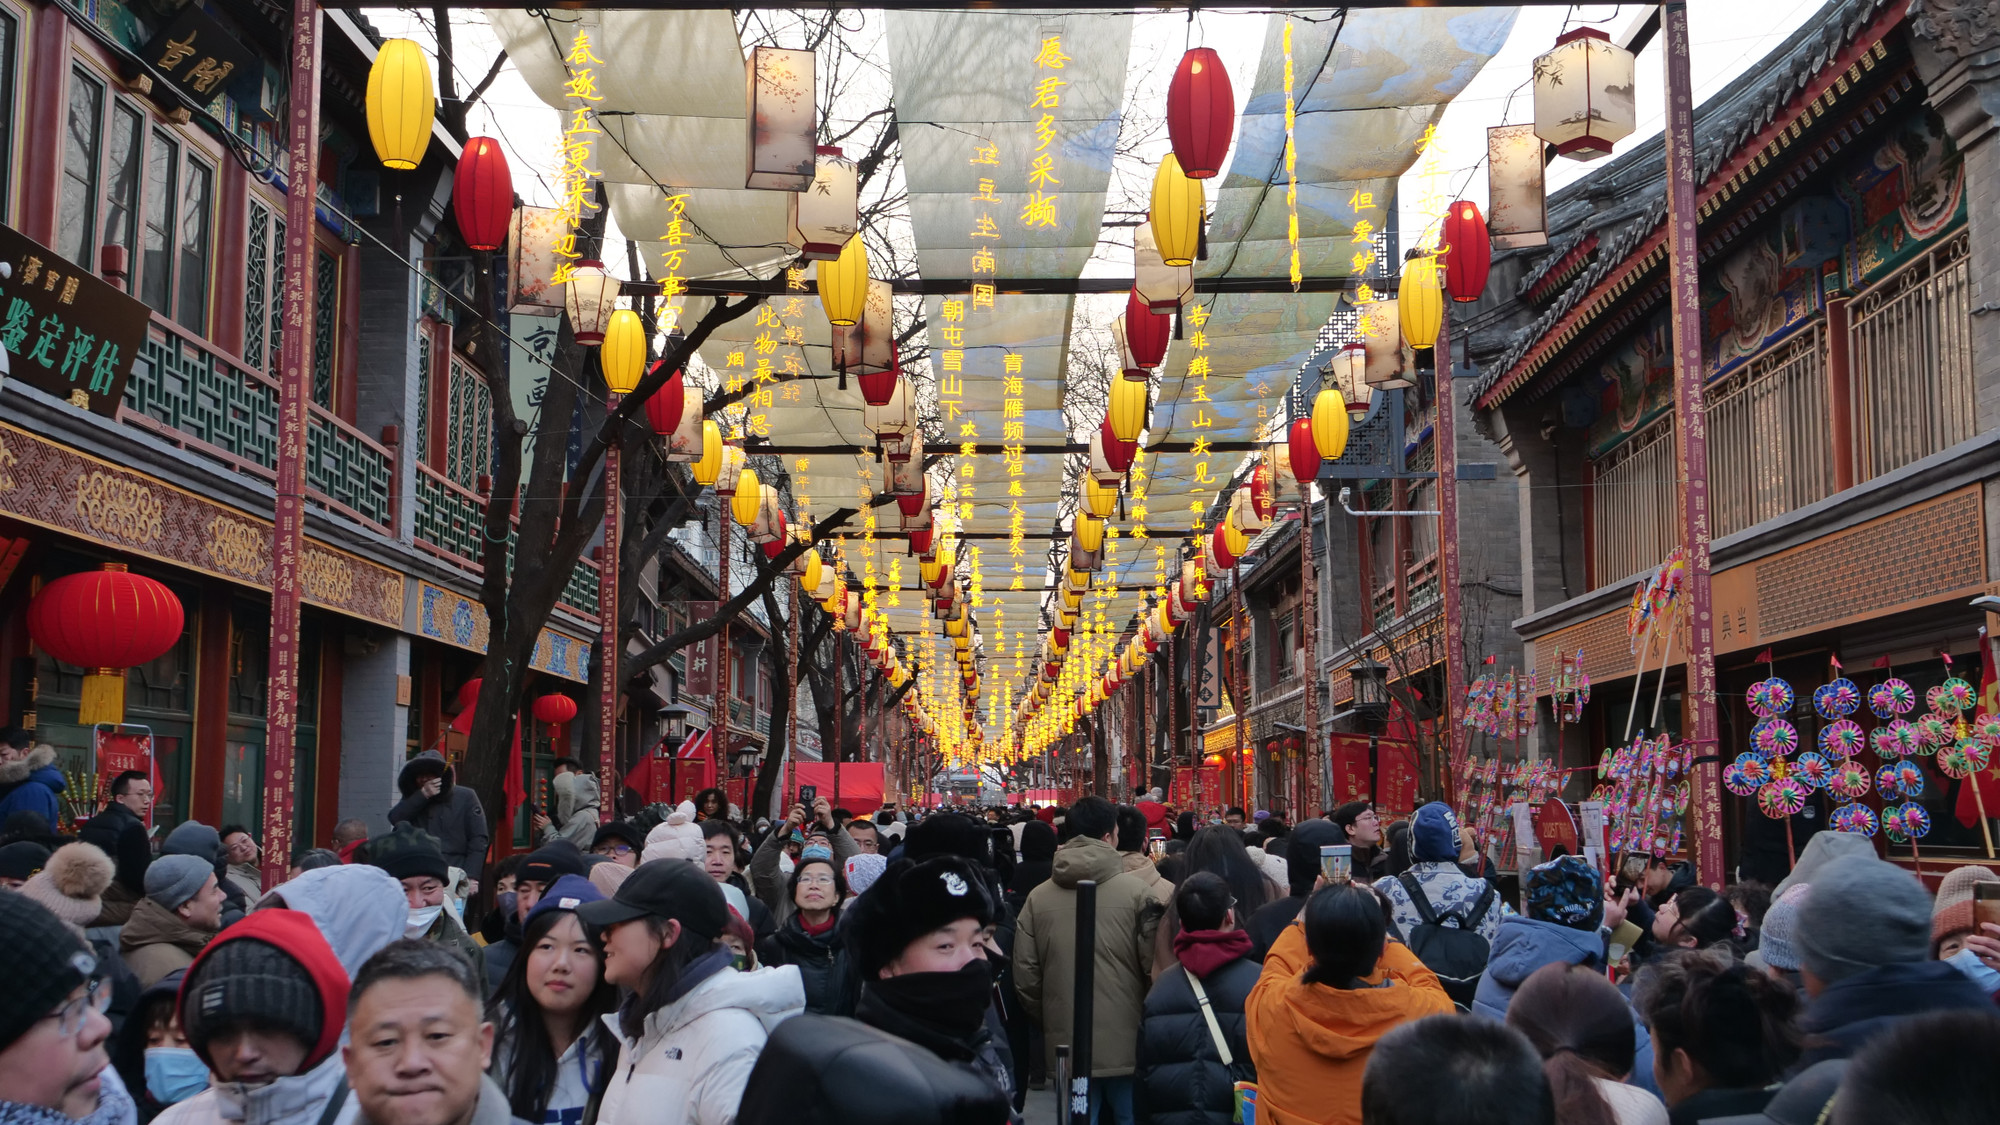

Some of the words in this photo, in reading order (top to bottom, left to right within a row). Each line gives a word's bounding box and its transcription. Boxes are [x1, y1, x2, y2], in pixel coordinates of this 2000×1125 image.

[564, 29, 603, 213] 春逐五更来
[1020, 36, 1072, 228] 愿君多采撷
[1348, 189, 1379, 339] 但爱鲈鱼美
[0, 287, 120, 396] 鉴定评估
[523, 325, 556, 454] 京画
[749, 305, 781, 435] 此物最相思
[941, 299, 965, 421] 朝屯雪山下
[1186, 304, 1216, 483] 若非群玉山头见
[725, 351, 747, 465] 烟村四五家
[1003, 353, 1025, 463] 青海雁频过
[959, 421, 978, 520] 欢笑白云窝
[1105, 526, 1120, 598] 能开二月花
[1190, 488, 1208, 599] 一程山水一年华
[993, 597, 1005, 653] 八九十枝花
